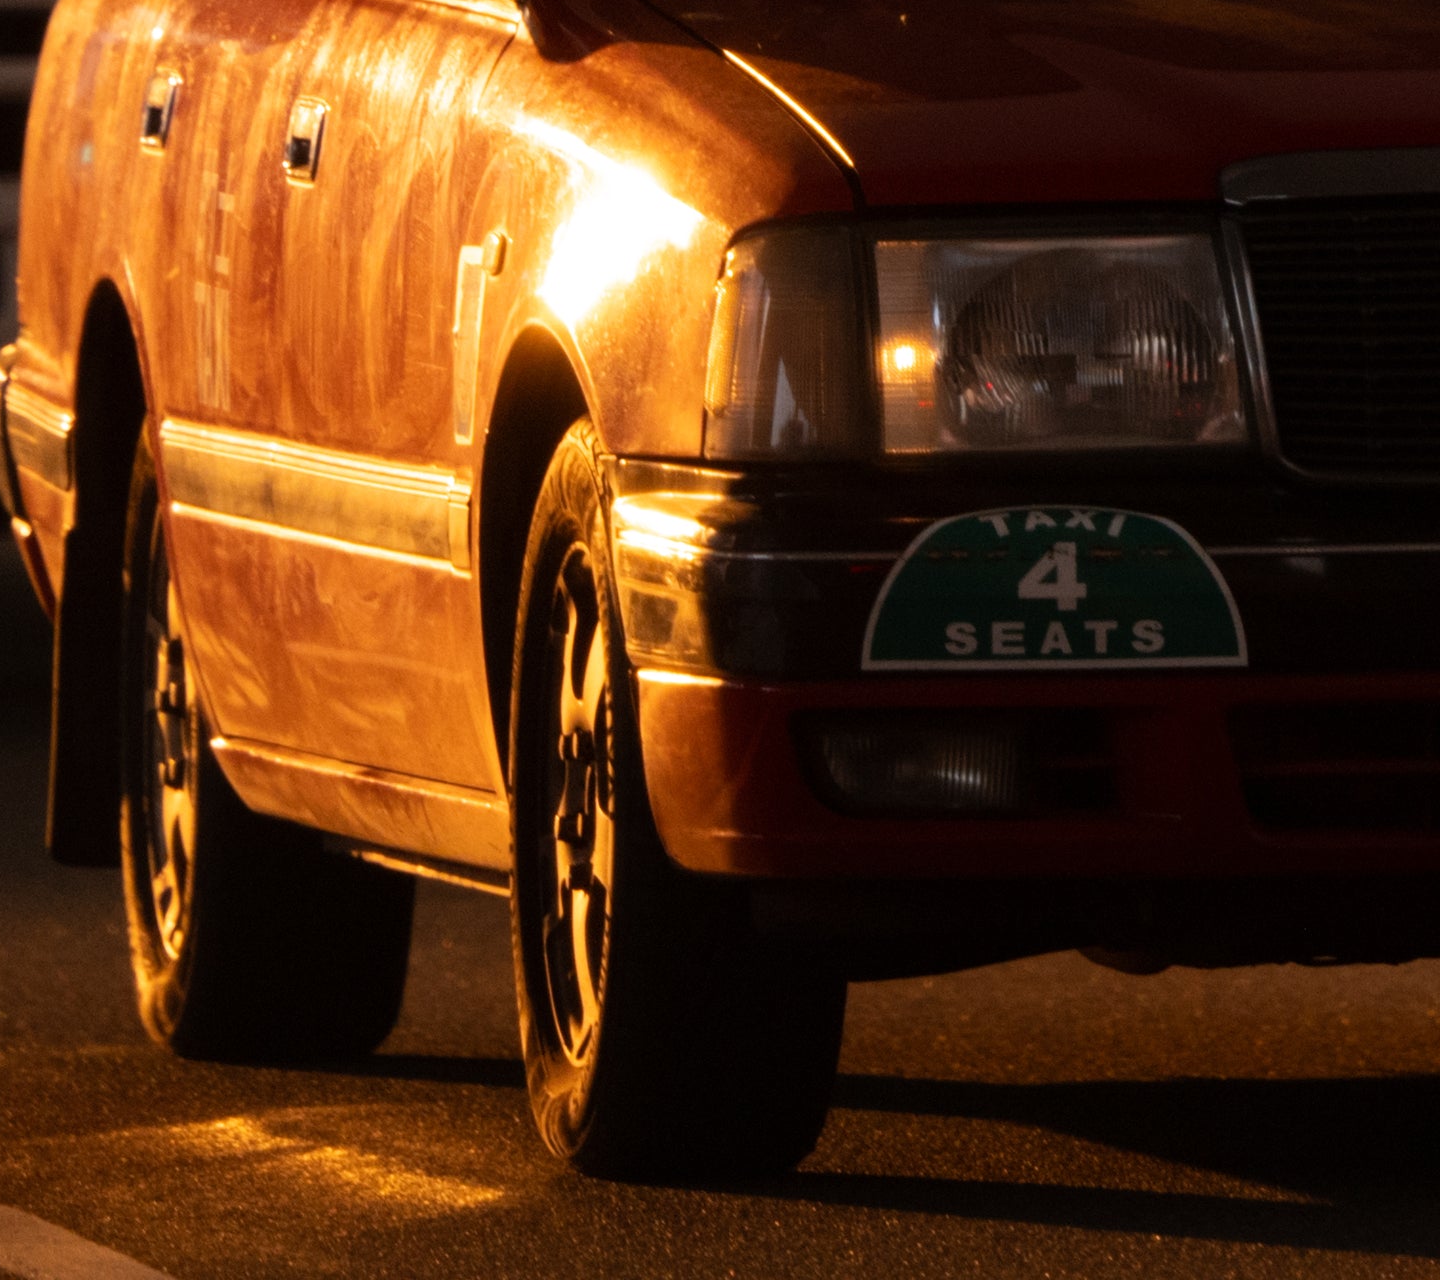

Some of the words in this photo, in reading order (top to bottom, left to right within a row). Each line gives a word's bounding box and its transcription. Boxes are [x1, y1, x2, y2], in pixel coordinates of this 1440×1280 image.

[978, 509, 1128, 538] TAXI
[1018, 541, 1087, 611] 4
[944, 619, 1166, 656] SEATS
